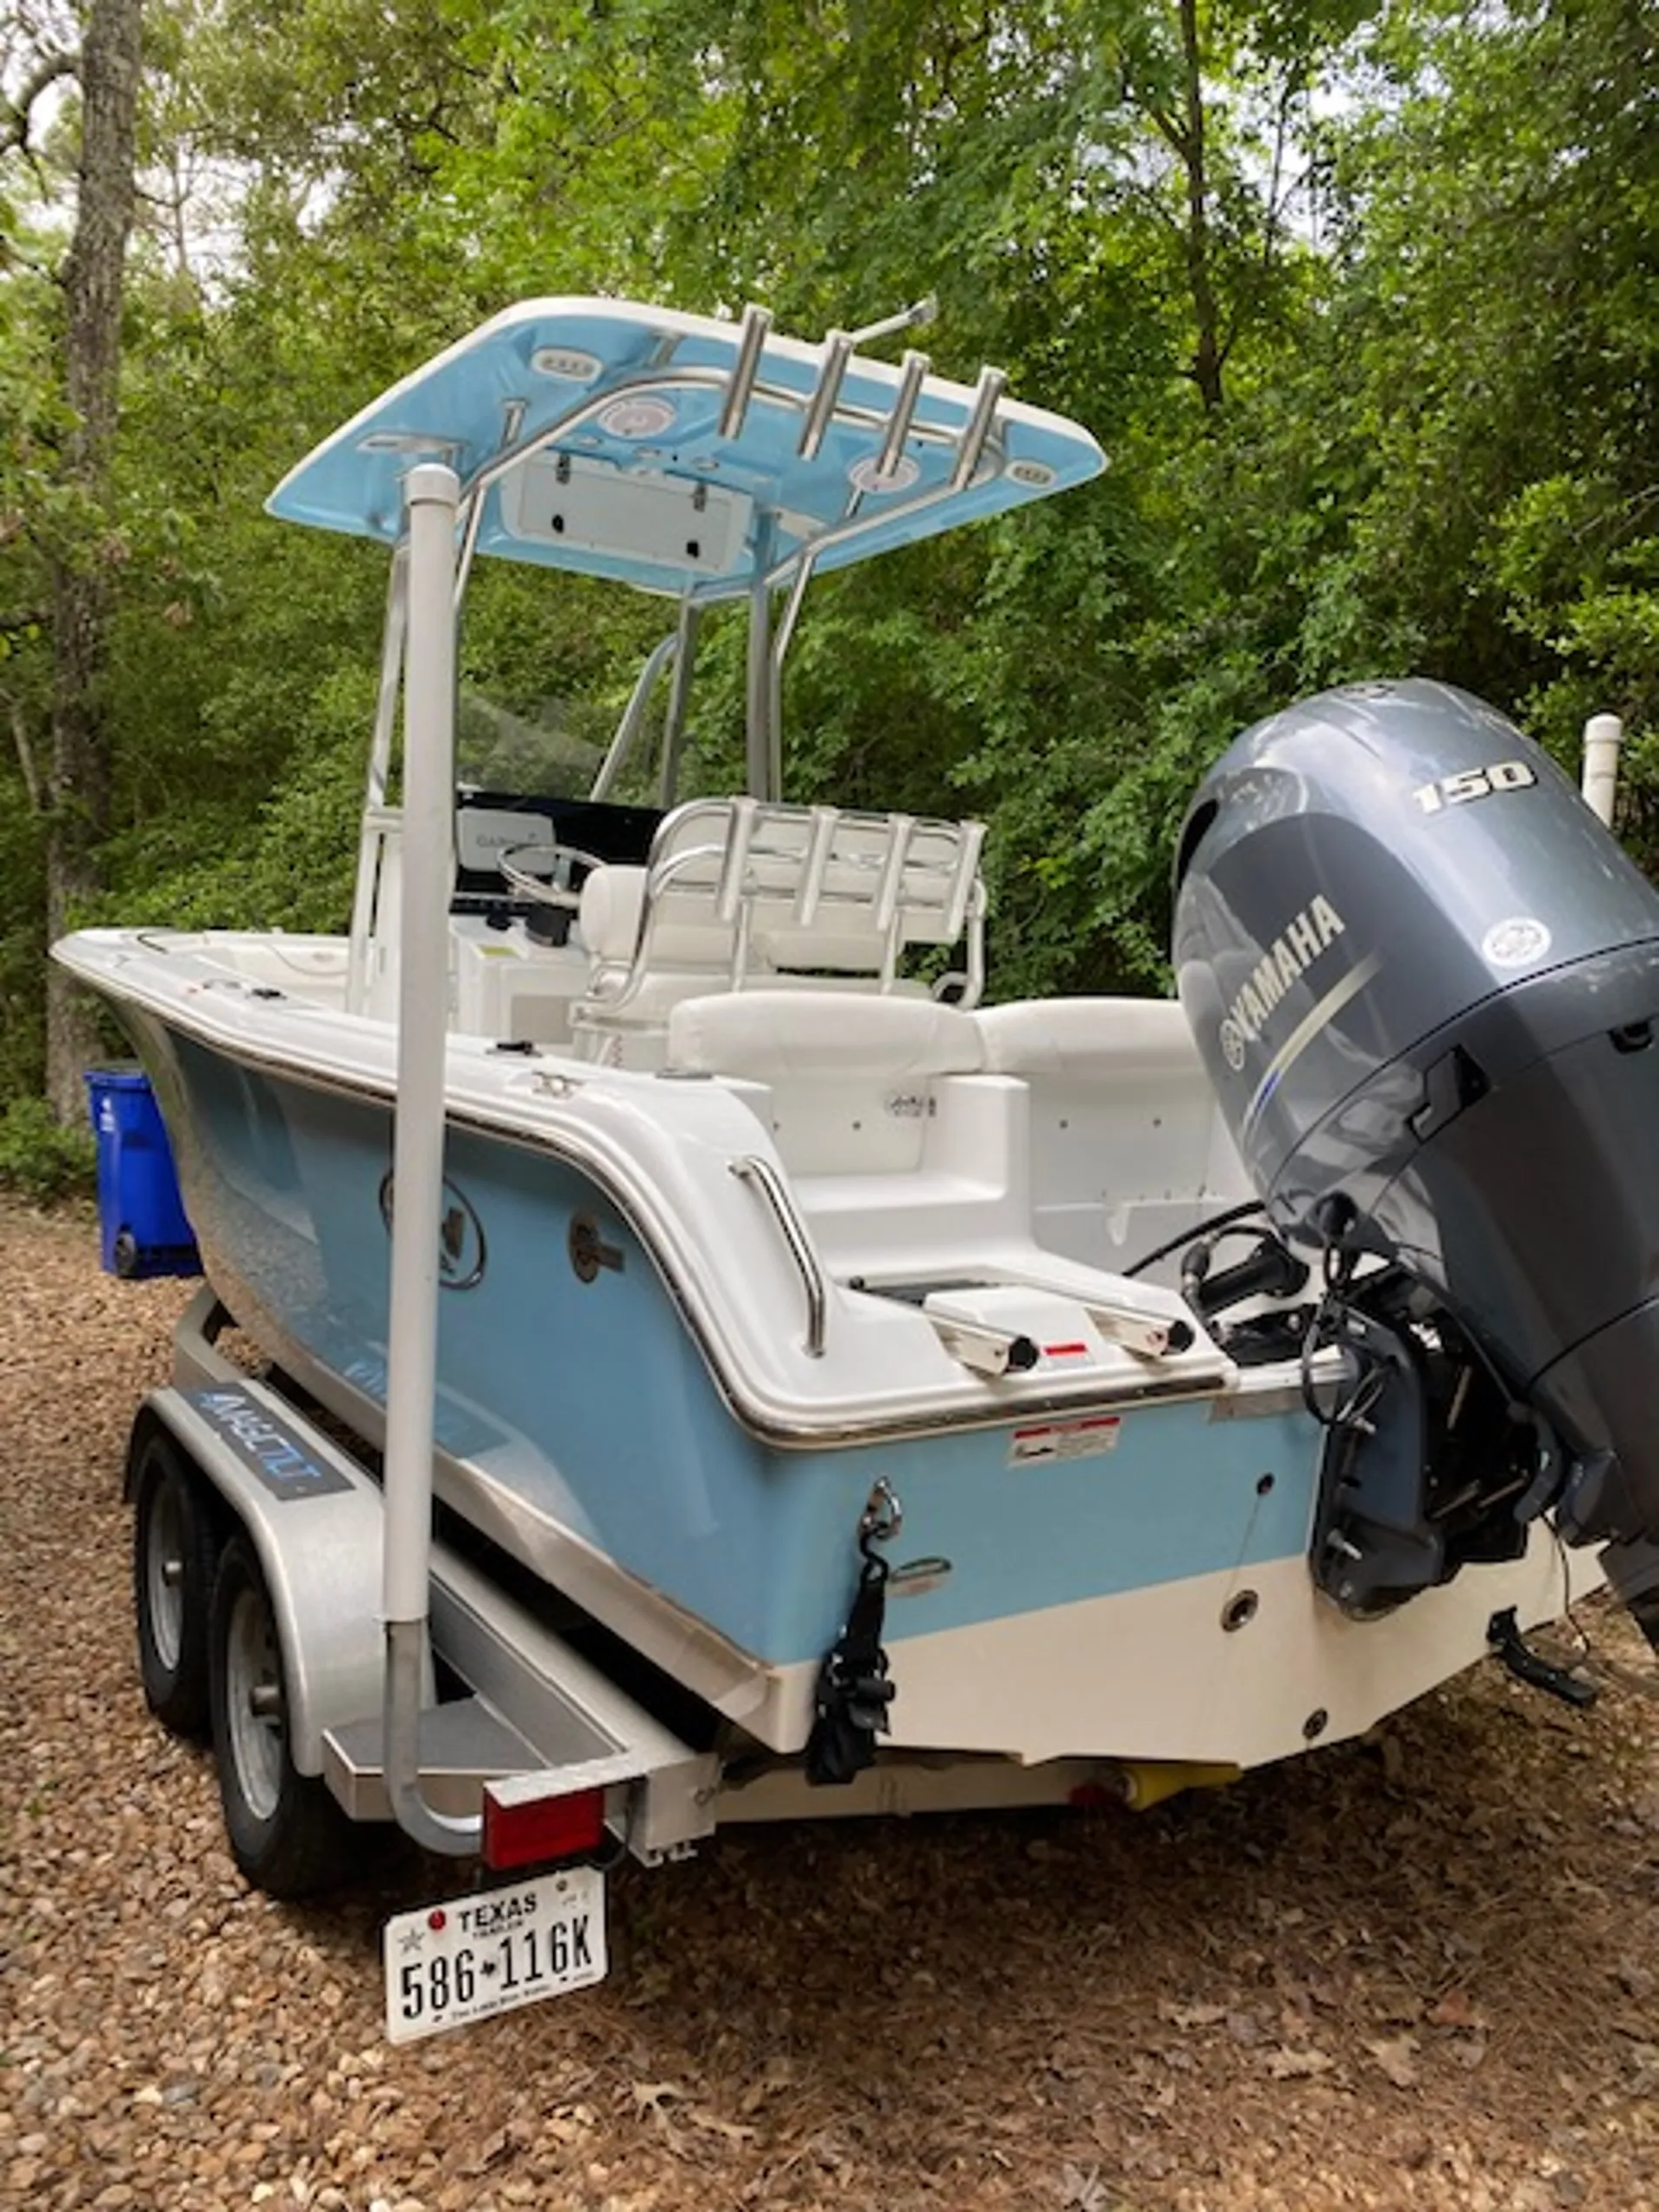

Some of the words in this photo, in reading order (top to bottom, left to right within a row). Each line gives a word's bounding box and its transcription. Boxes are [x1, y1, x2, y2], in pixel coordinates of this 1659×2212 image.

[1413, 761, 1537, 815] 150
[1231, 894, 1345, 1040] YAMAHA
[457, 1892, 537, 1932] TEXAS
